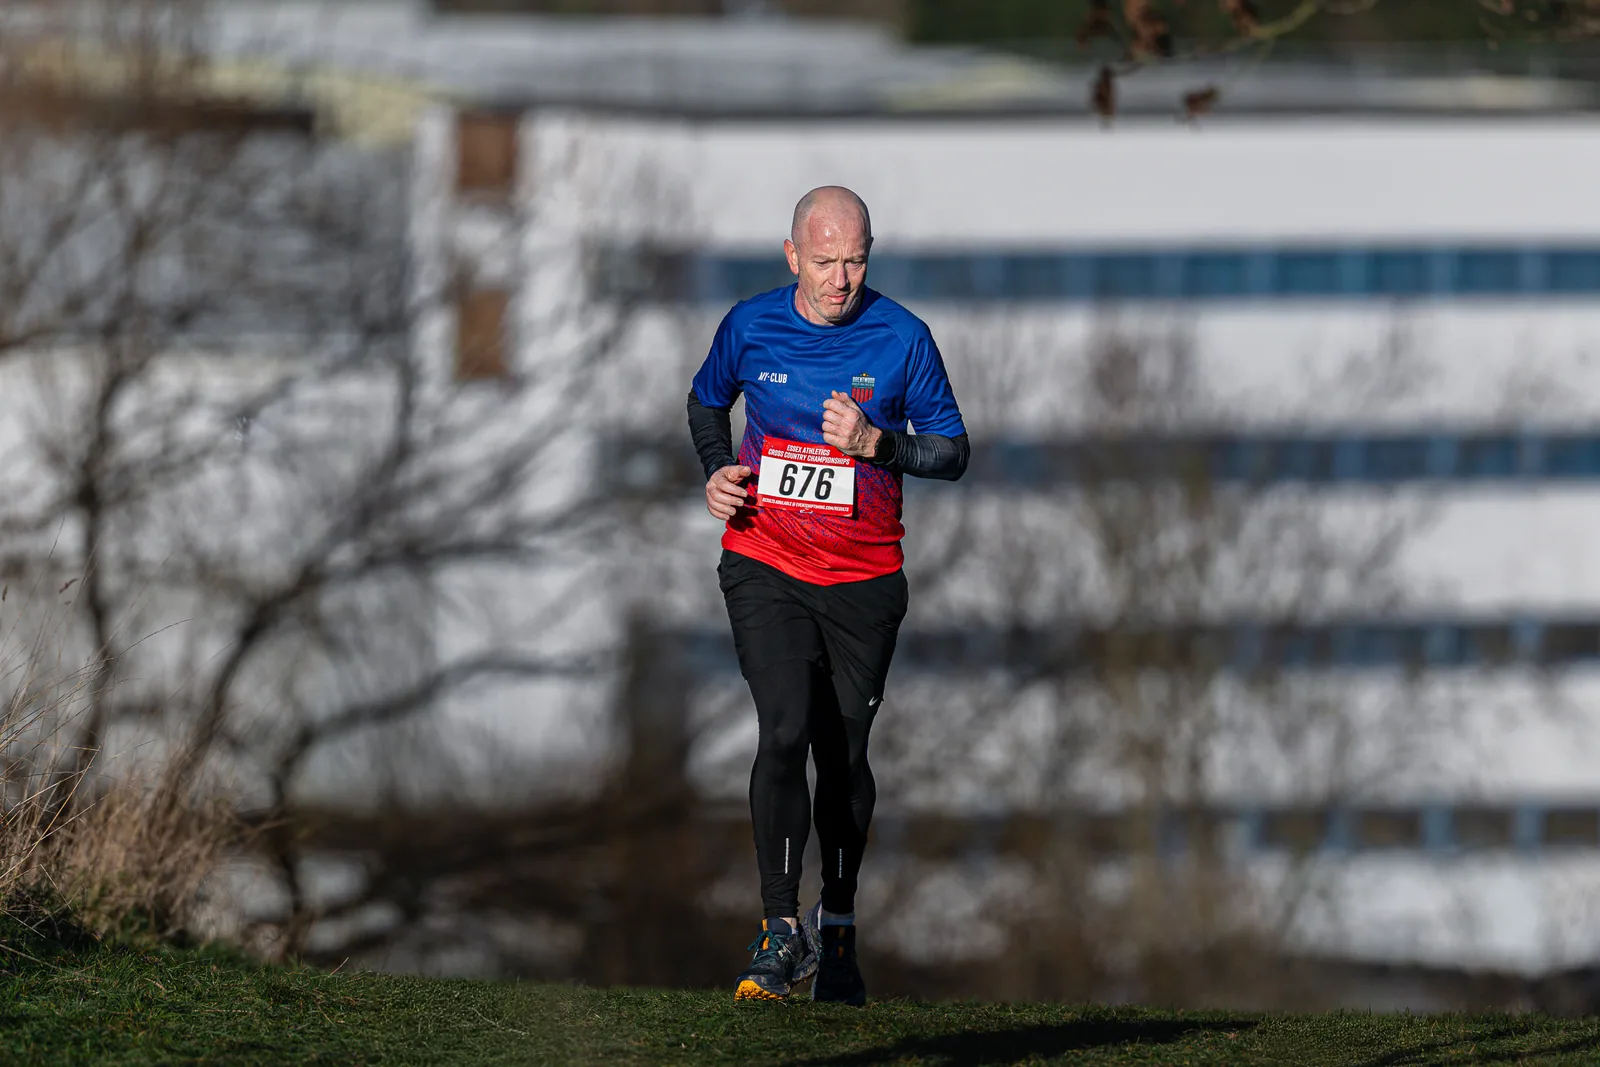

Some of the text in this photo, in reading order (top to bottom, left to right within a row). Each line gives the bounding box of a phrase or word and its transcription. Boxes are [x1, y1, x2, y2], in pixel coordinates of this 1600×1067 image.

[768, 448, 851, 465] CROSS COUNTRY CHAMPIONSHIPS
[787, 444, 831, 456] ESSEX ATHLETICS
[778, 463, 835, 500] 676
